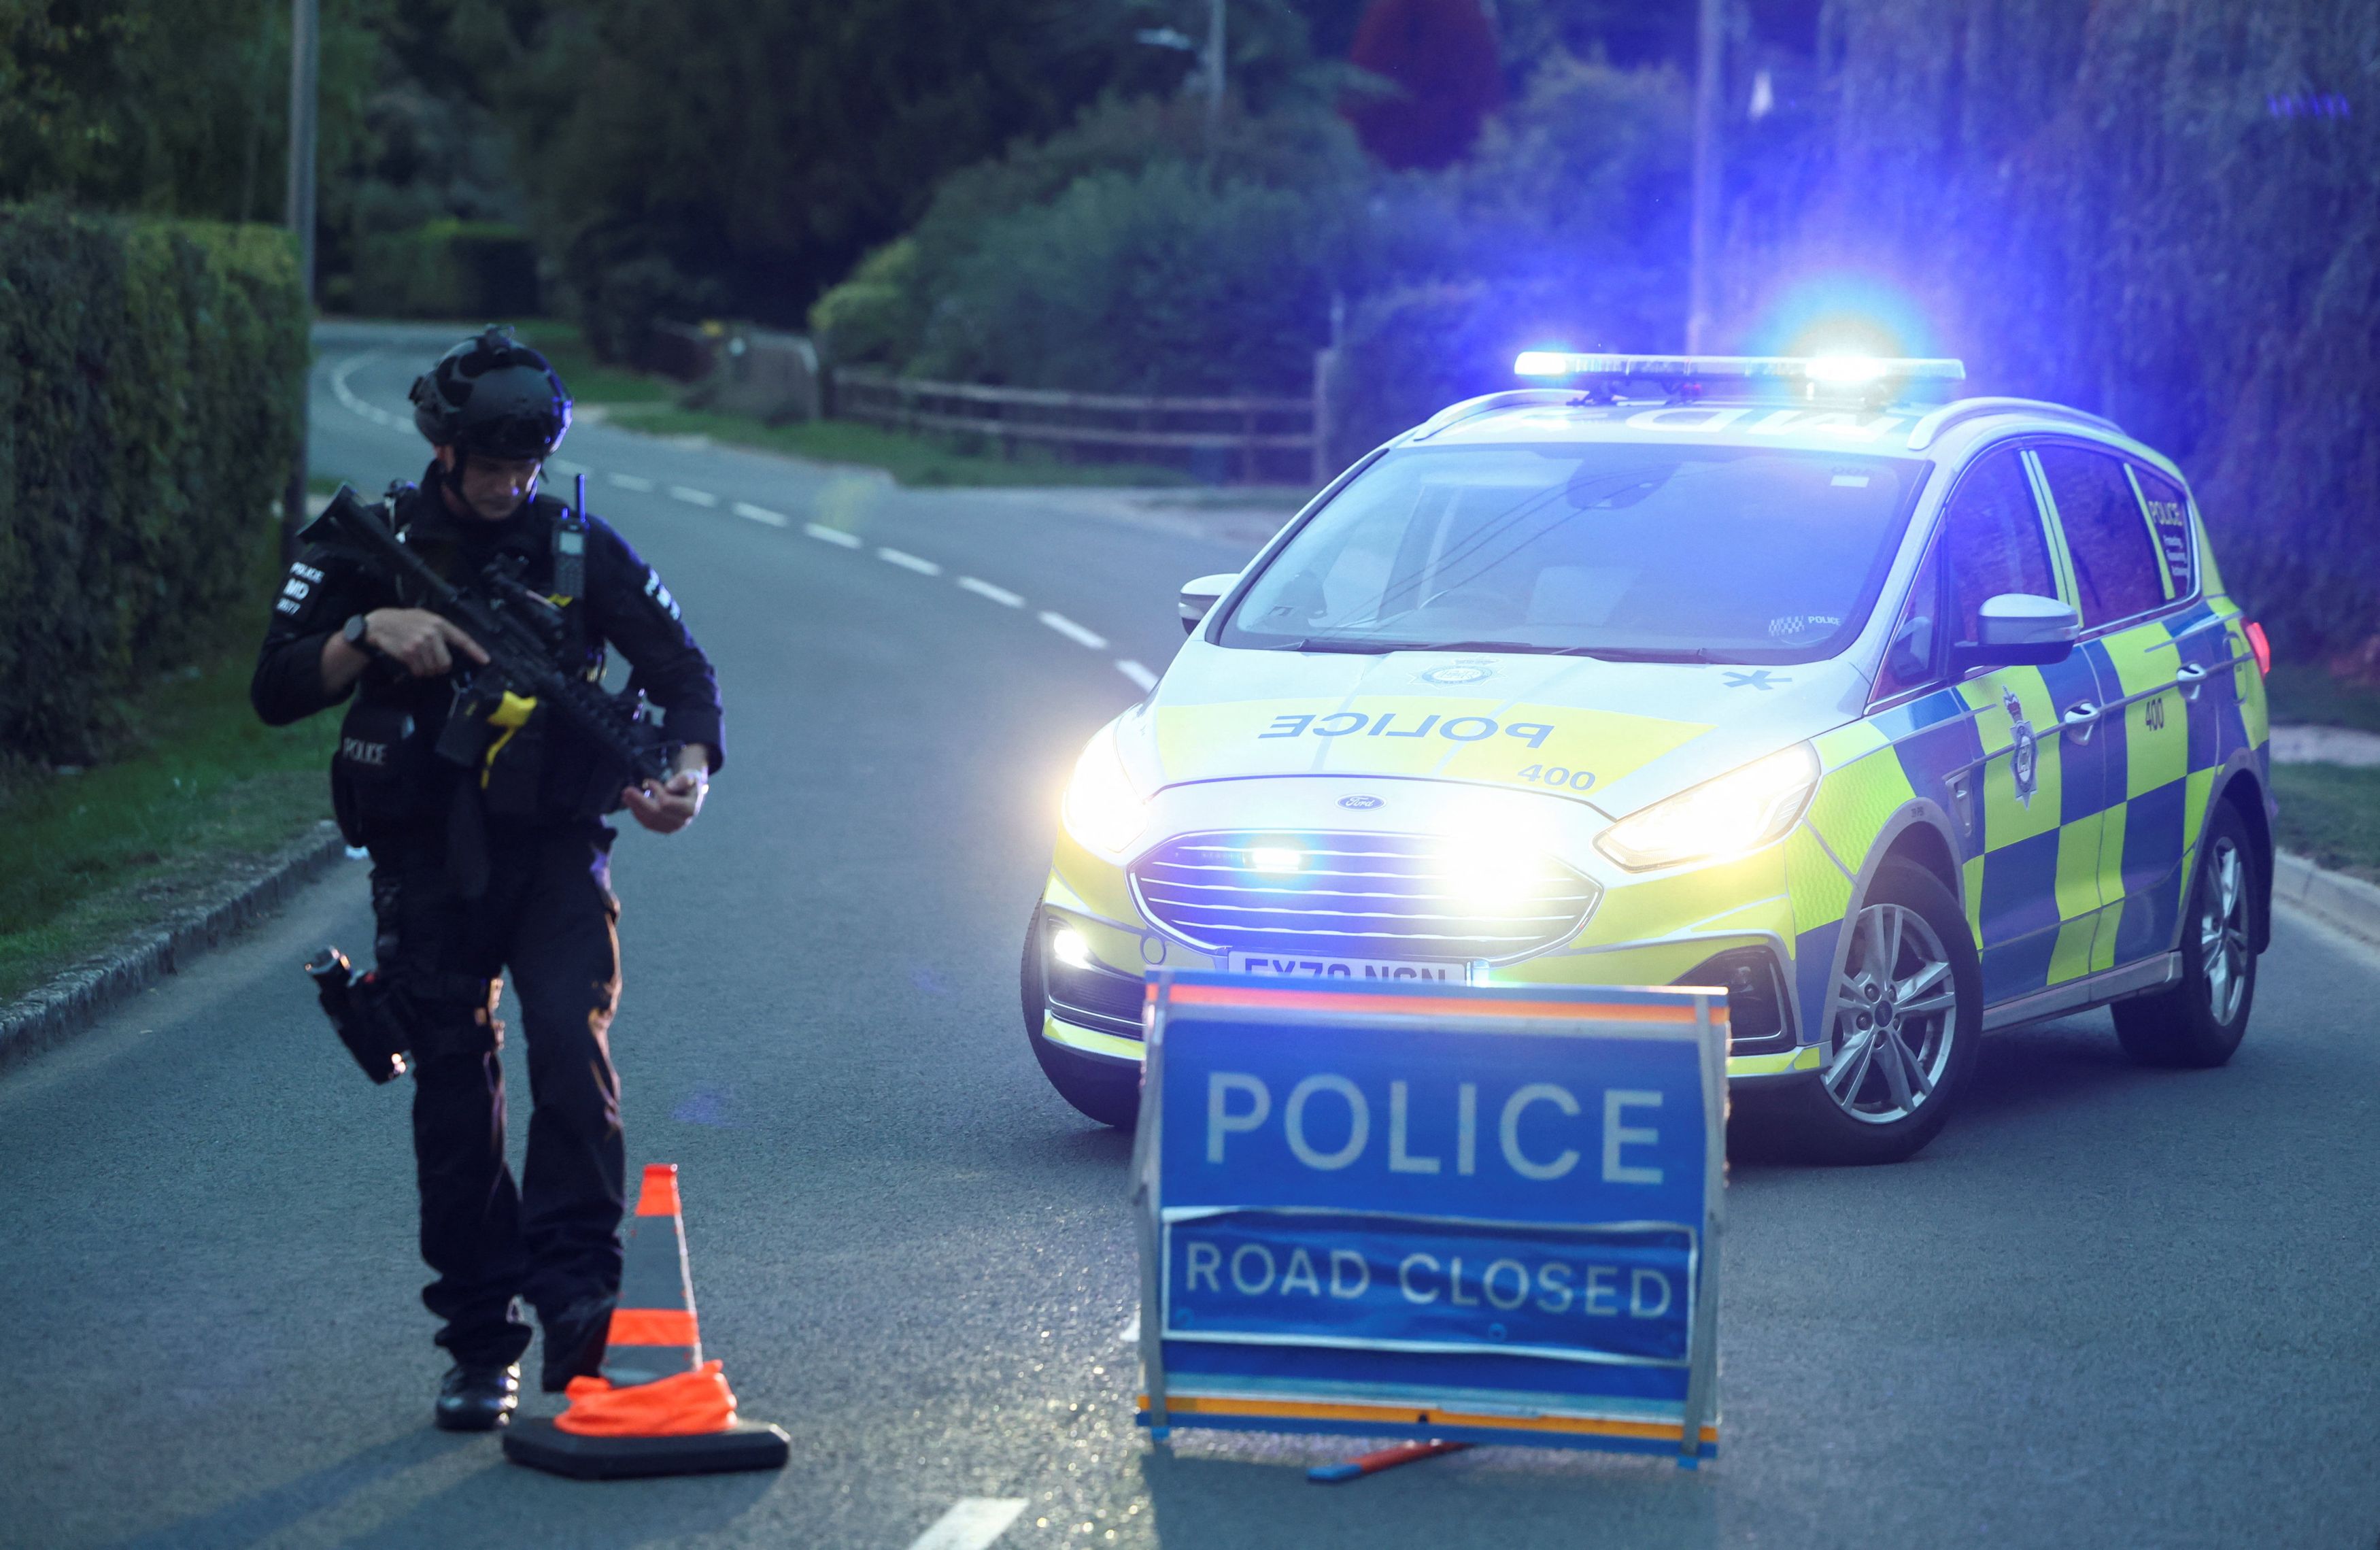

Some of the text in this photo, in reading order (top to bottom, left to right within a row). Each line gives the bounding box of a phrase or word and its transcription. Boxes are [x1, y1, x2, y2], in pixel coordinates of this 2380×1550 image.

[2148, 501, 2183, 526] POLICE
[290, 562, 325, 584] POLICE
[283, 577, 309, 601] MD
[1808, 616, 1841, 626] POLICE
[2145, 698, 2164, 732] 400
[343, 737, 387, 766] POLICE
[1517, 764, 1596, 790] 400
[1346, 796, 1375, 807] Ford
[1206, 1072, 1664, 1185] POLICE
[1186, 1242, 1671, 1318] ROAD CLOSED
